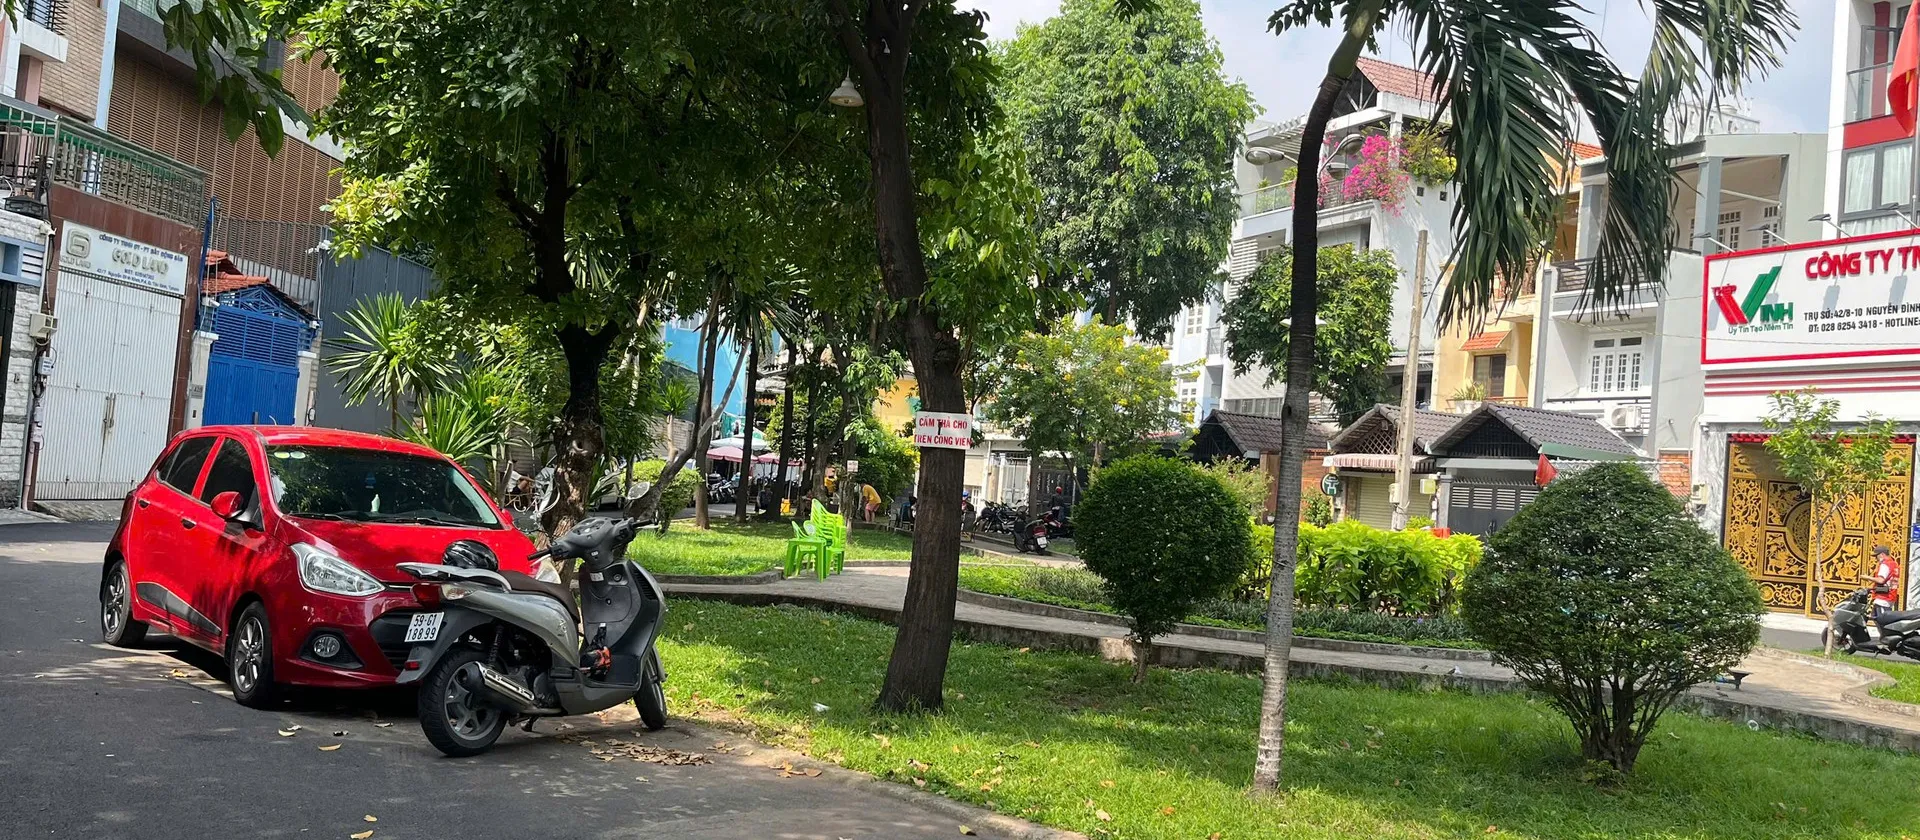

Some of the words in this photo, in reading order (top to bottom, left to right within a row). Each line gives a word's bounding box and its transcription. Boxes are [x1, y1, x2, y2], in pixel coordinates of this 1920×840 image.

[113, 237, 120, 245] TY
[112, 247, 141, 268] GOLD
[142, 255, 169, 275] LAND
[1805, 251, 1862, 279] CÔNG
[1865, 248, 1895, 273] TY
[1804, 311, 1819, 322] TRỤ
[1866, 303, 1898, 316] NGUYỄN
[1901, 302, 1920, 313] ĐÌNH
[1808, 324, 1820, 333] ĐT:
[1821, 323, 1835, 332] 028
[1837, 322, 1856, 331] 6254
[1858, 320, 1877, 329] 3418
[414, 614, 437, 627] 59-G1
[407, 627, 436, 641] 188.99
